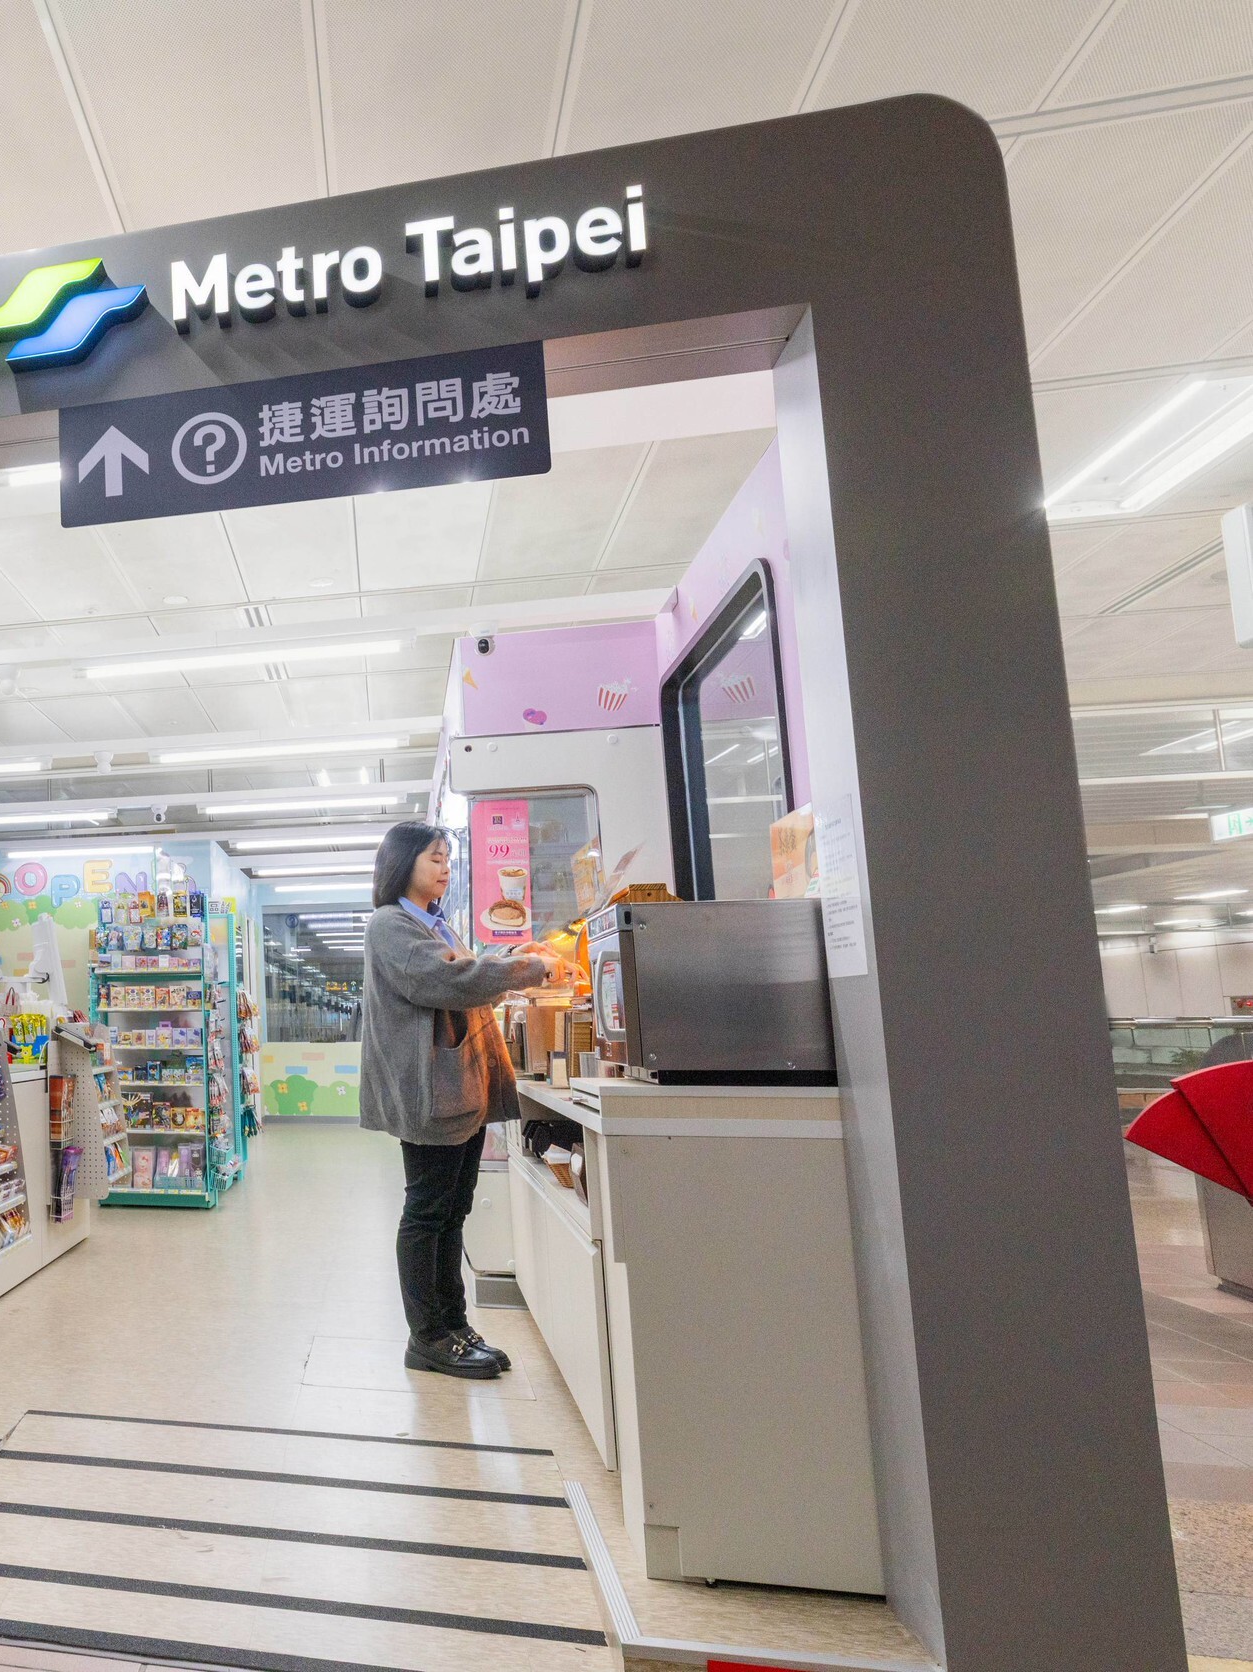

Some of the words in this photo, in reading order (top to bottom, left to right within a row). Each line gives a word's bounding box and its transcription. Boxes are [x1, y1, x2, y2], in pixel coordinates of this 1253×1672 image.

[171, 246, 384, 323] Metro
[405, 184, 647, 283] Taipei
[258, 371, 522, 448] 捷運詢問處
[259, 450, 344, 477] Metro
[353, 423, 530, 465] Information
[489, 844, 510, 858] 99
